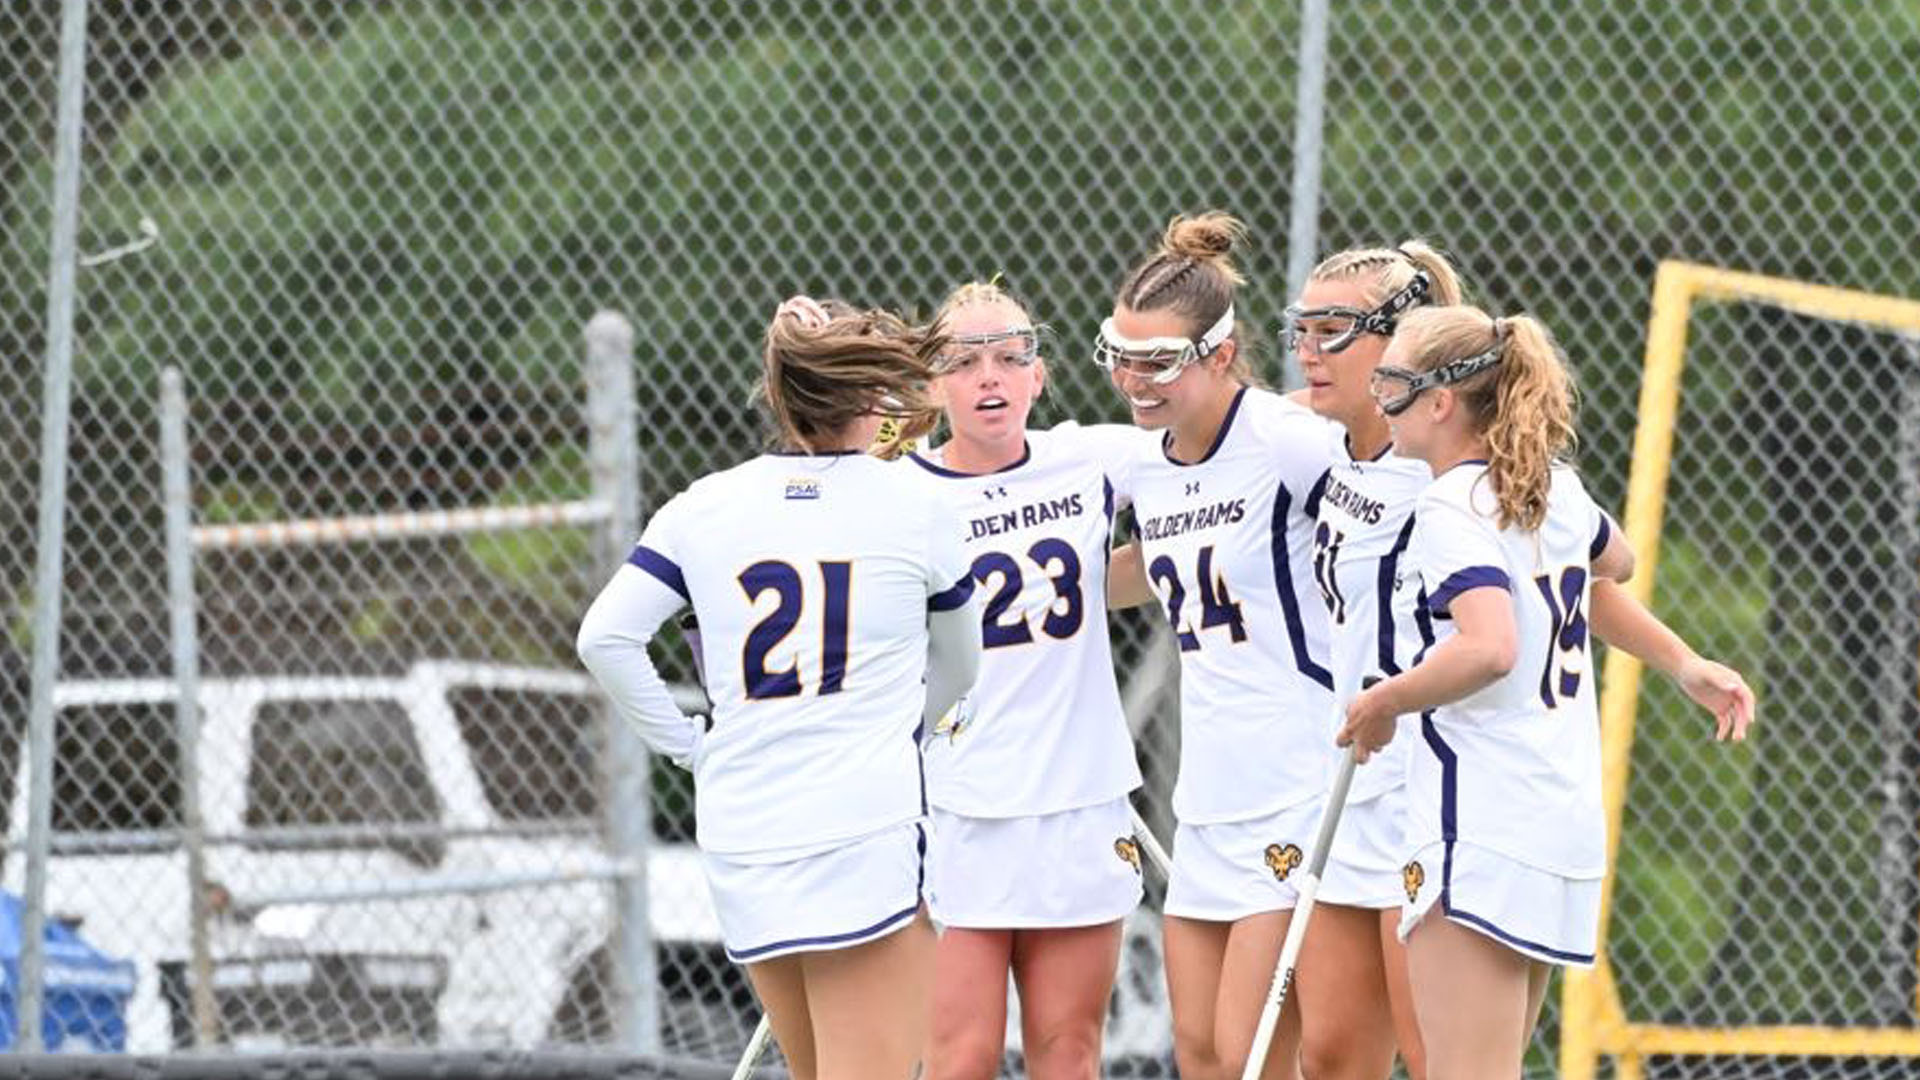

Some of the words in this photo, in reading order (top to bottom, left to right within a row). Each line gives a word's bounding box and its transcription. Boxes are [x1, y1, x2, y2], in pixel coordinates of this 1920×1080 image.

[965, 511, 1018, 543] DEN
[1022, 494, 1083, 528] RAMS
[1193, 498, 1246, 531] RAMS
[736, 558, 853, 701] 21
[970, 537, 1084, 650] 23
[1148, 544, 1248, 652] 24
[1534, 565, 1588, 709] 19
